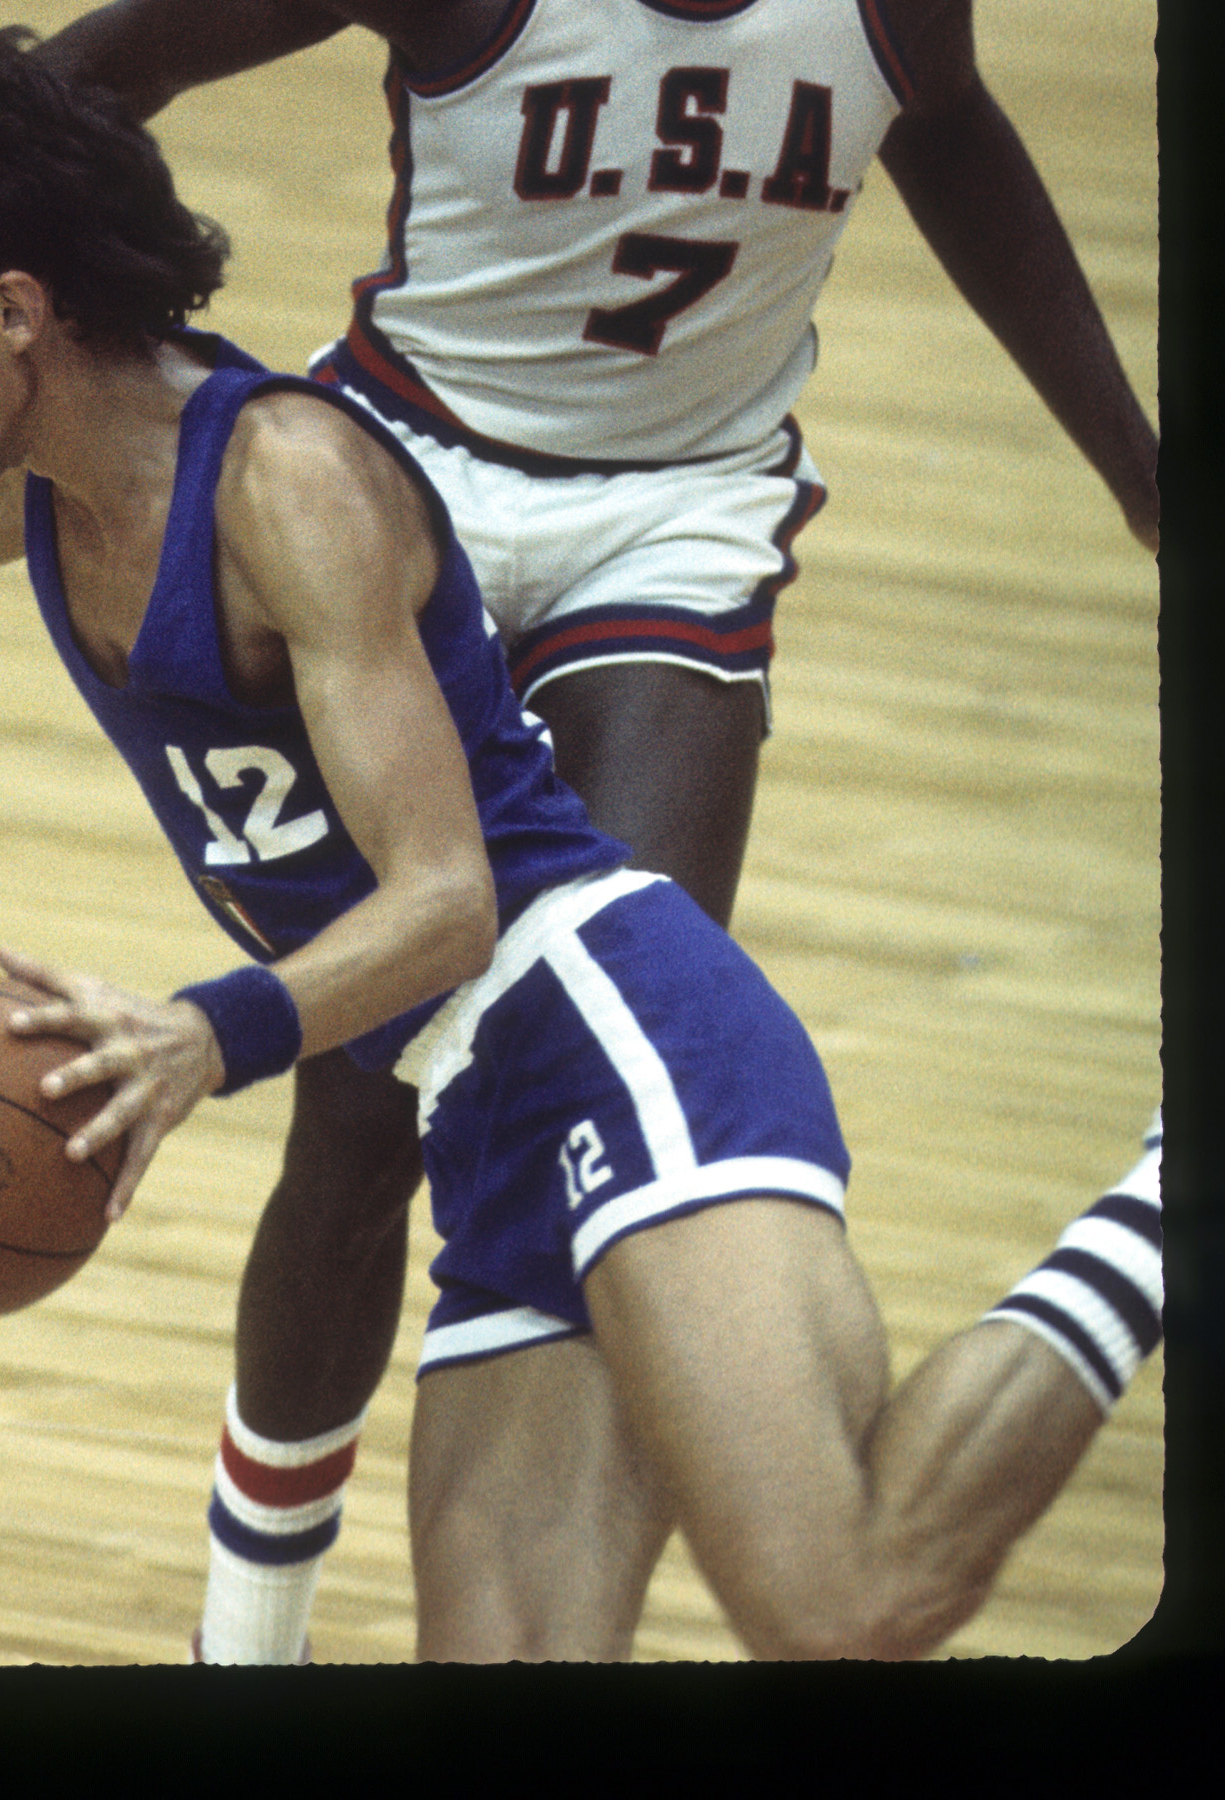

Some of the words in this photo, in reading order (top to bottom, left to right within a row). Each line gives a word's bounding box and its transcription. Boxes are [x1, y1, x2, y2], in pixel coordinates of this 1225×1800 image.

[513, 66, 851, 213] U.S.A.
[582, 231, 740, 356] 7
[165, 744, 329, 865] 12
[558, 1118, 613, 1210] 12
